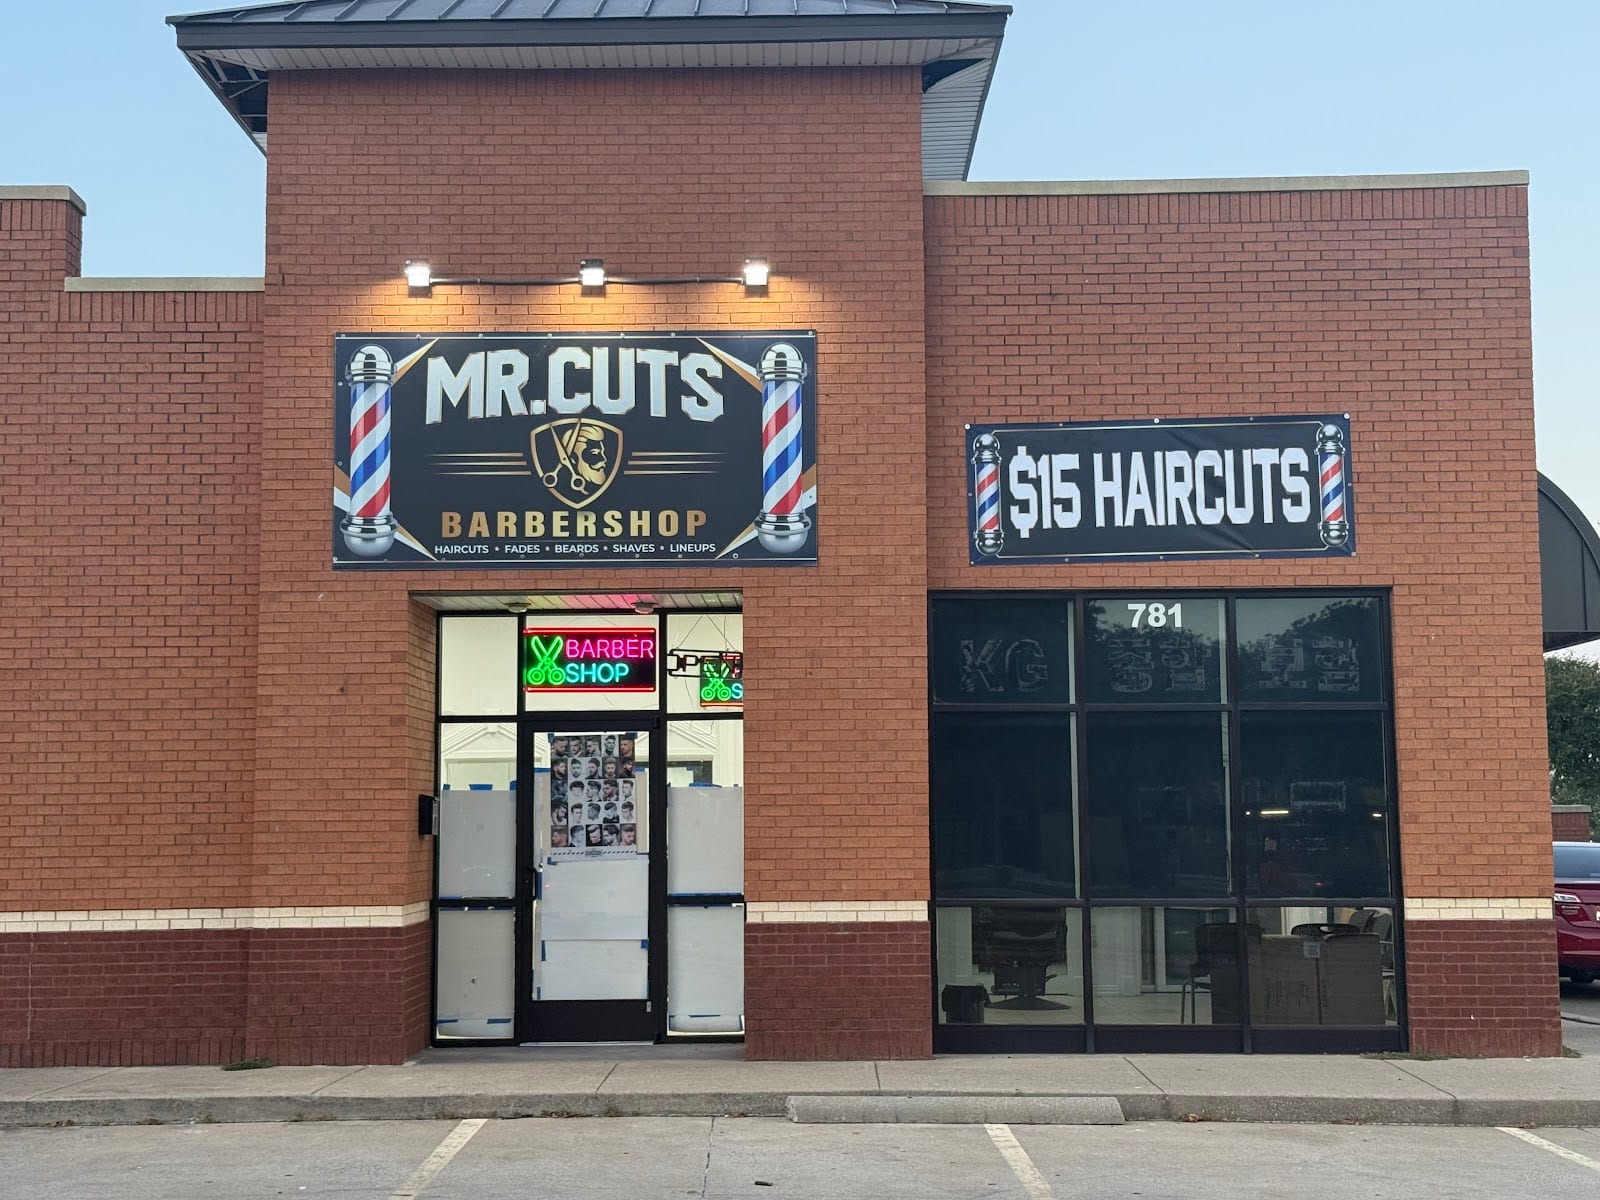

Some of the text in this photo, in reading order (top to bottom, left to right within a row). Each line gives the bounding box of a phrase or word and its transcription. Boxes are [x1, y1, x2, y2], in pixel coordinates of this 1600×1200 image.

[426, 347, 723, 424] MR.CUTS
[1008, 445, 1312, 539] $15 HAIRCUTS
[441, 510, 708, 539] BARBERSHOP
[434, 544, 716, 554] HAIRCUTS FADES BEARDS SHAVES LINEUPS
[1127, 603, 1183, 628] 781
[565, 639, 654, 658] BARBER
[565, 662, 629, 683] SHOP
